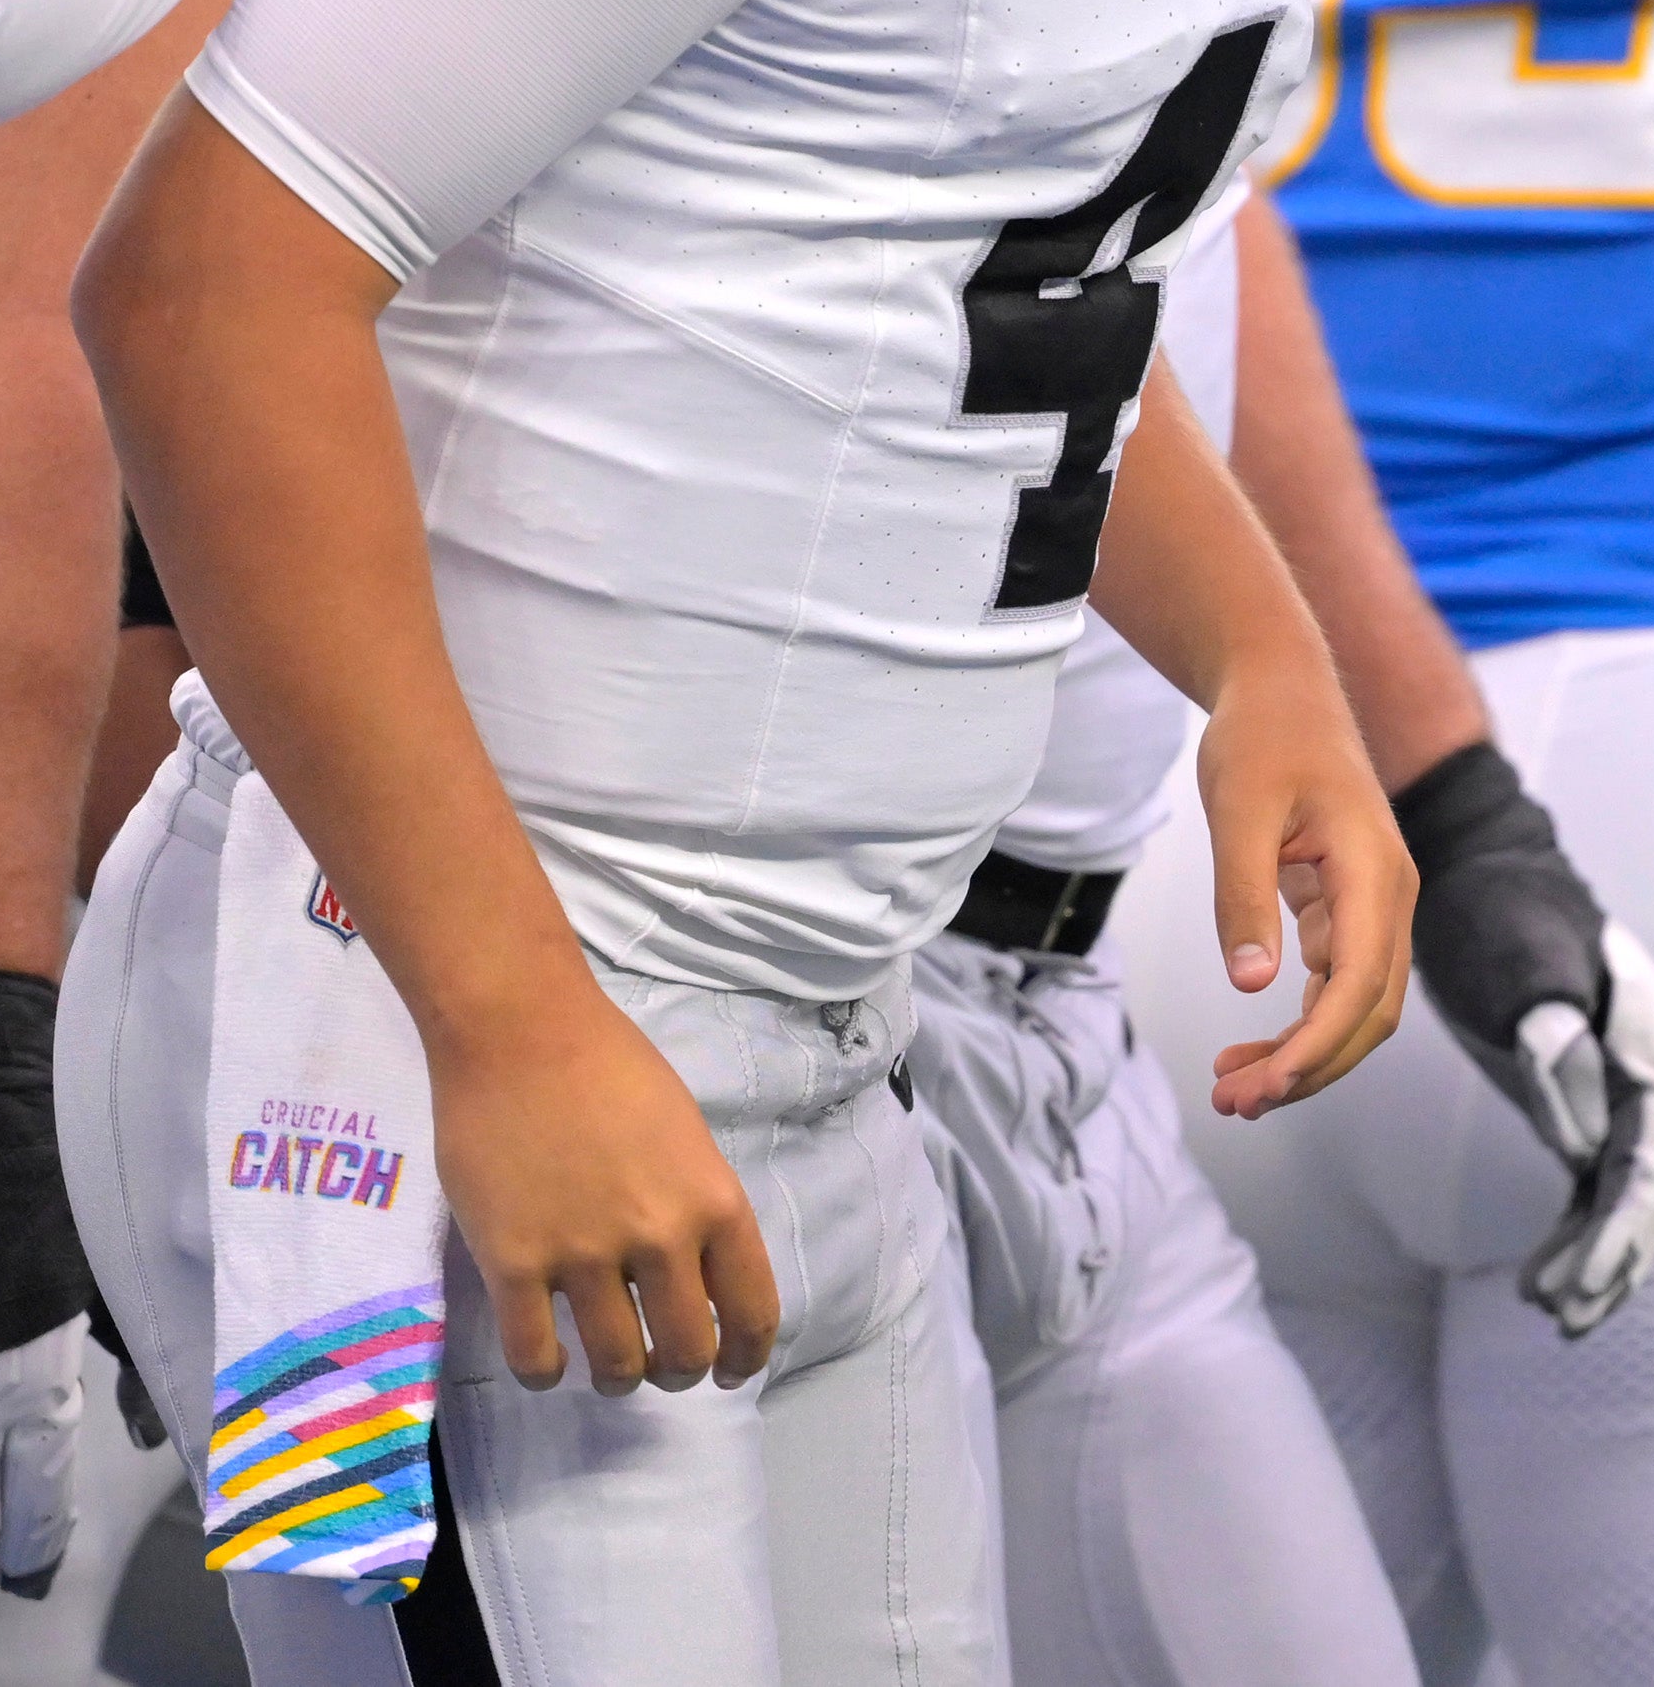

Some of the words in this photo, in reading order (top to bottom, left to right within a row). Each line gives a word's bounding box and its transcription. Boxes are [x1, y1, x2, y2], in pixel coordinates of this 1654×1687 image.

[958, 17, 1277, 611] 4
[260, 1099, 378, 1141] CRUCIAL
[229, 1130, 405, 1211] CATCH
